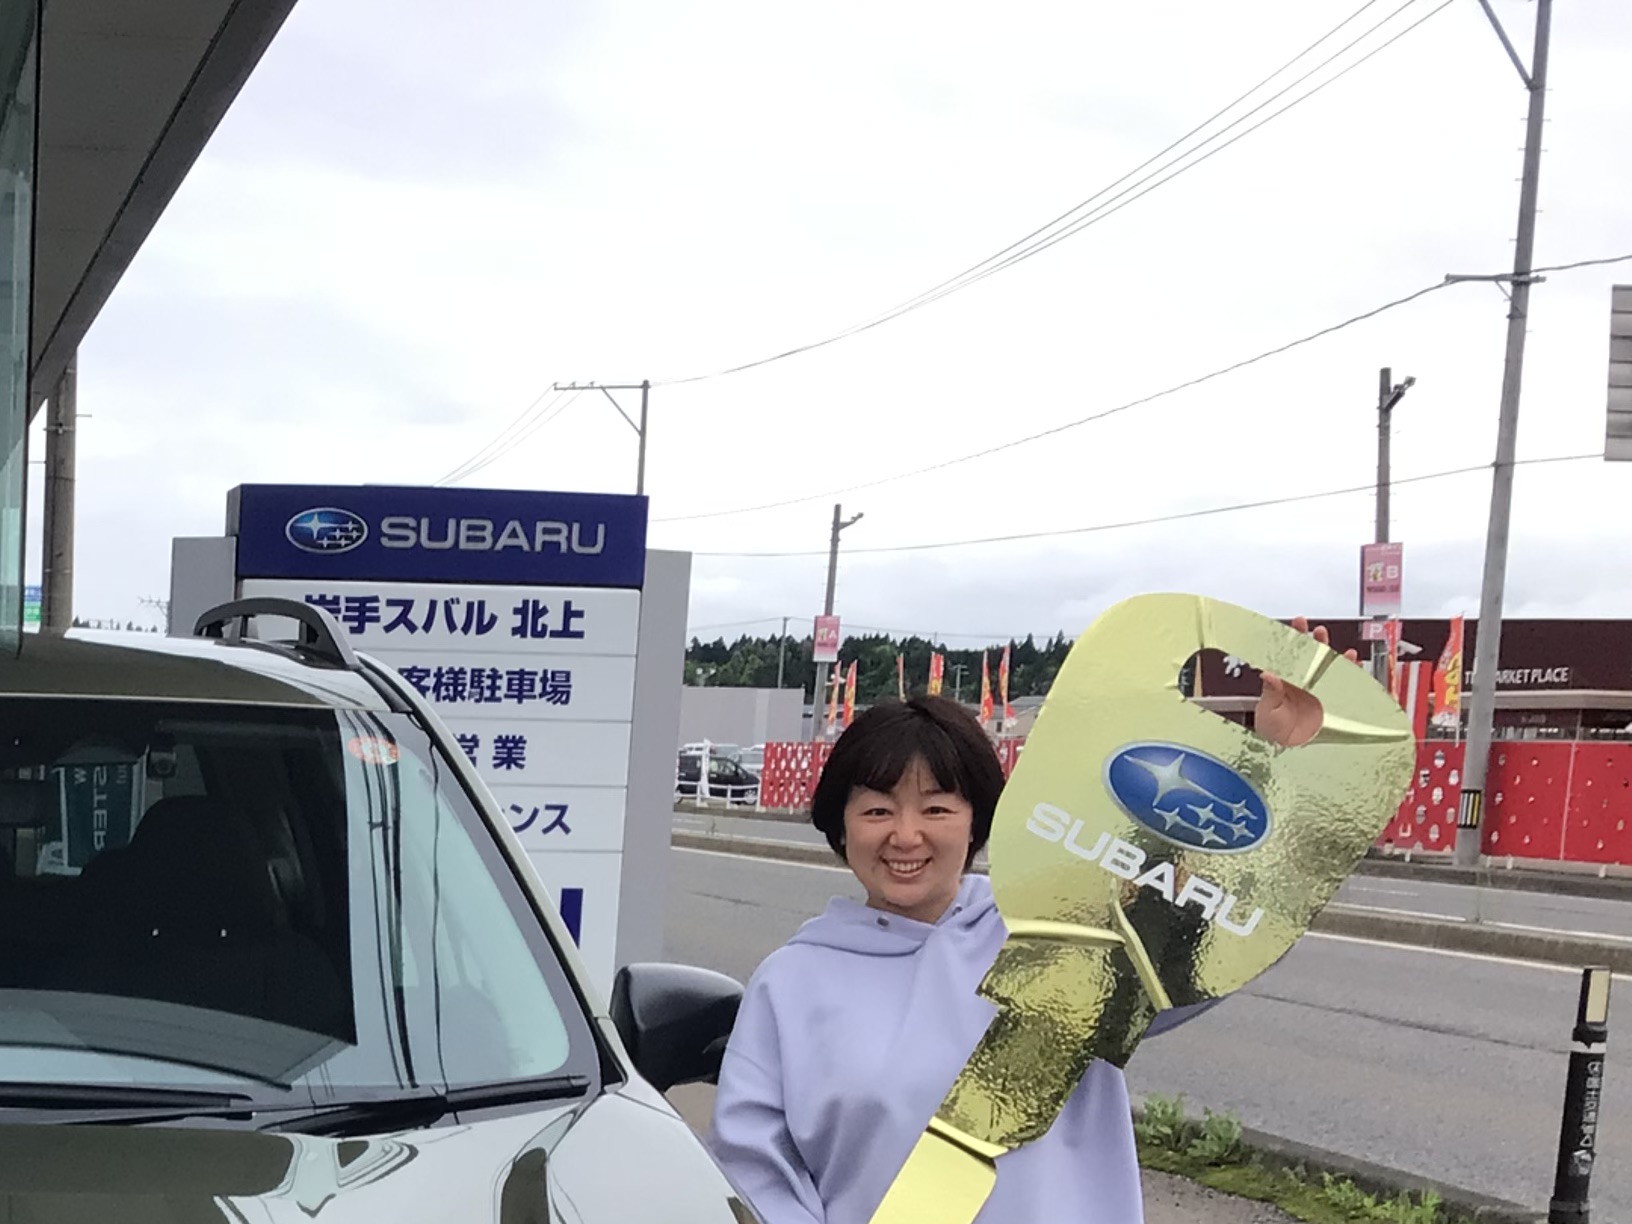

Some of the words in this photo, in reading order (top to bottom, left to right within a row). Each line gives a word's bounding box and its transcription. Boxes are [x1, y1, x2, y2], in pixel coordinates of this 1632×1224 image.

[379, 516, 606, 554] SUBARU
[511, 599, 585, 639] 北上
[1493, 668, 1530, 685] ARKET
[1531, 667, 1569, 683] PLACE
[506, 803, 572, 835] ンス
[1025, 802, 1265, 937] SUBARU
